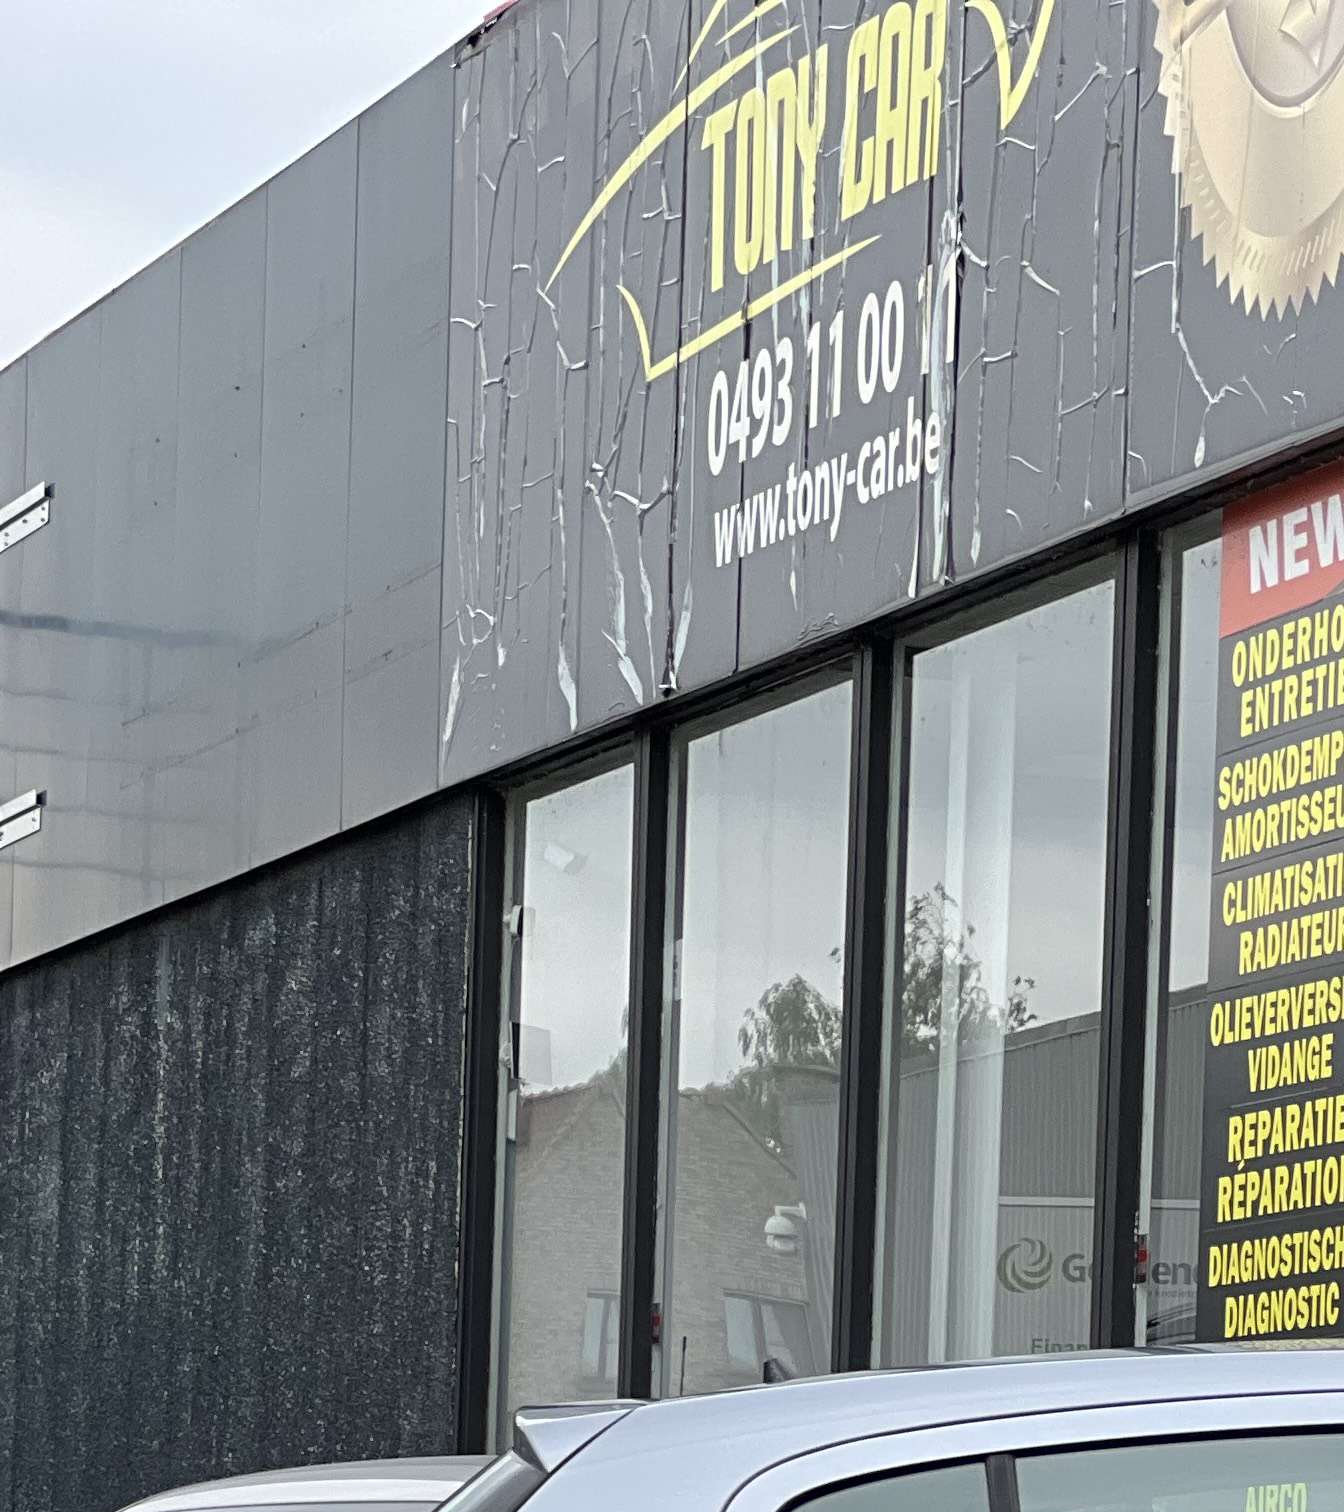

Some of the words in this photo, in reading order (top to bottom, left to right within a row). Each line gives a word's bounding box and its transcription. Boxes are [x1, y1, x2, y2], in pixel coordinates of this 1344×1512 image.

[841, 0, 948, 221] CAR
[707, 337, 793, 476] 0493
[806, 310, 845, 429] 11
[857, 280, 904, 404] 00
[714, 396, 941, 567] www.tony-car.be
[1248, 1033, 1334, 1093] VIDANGE
[1224, 1282, 1340, 1339] DIAGNOSTIC
